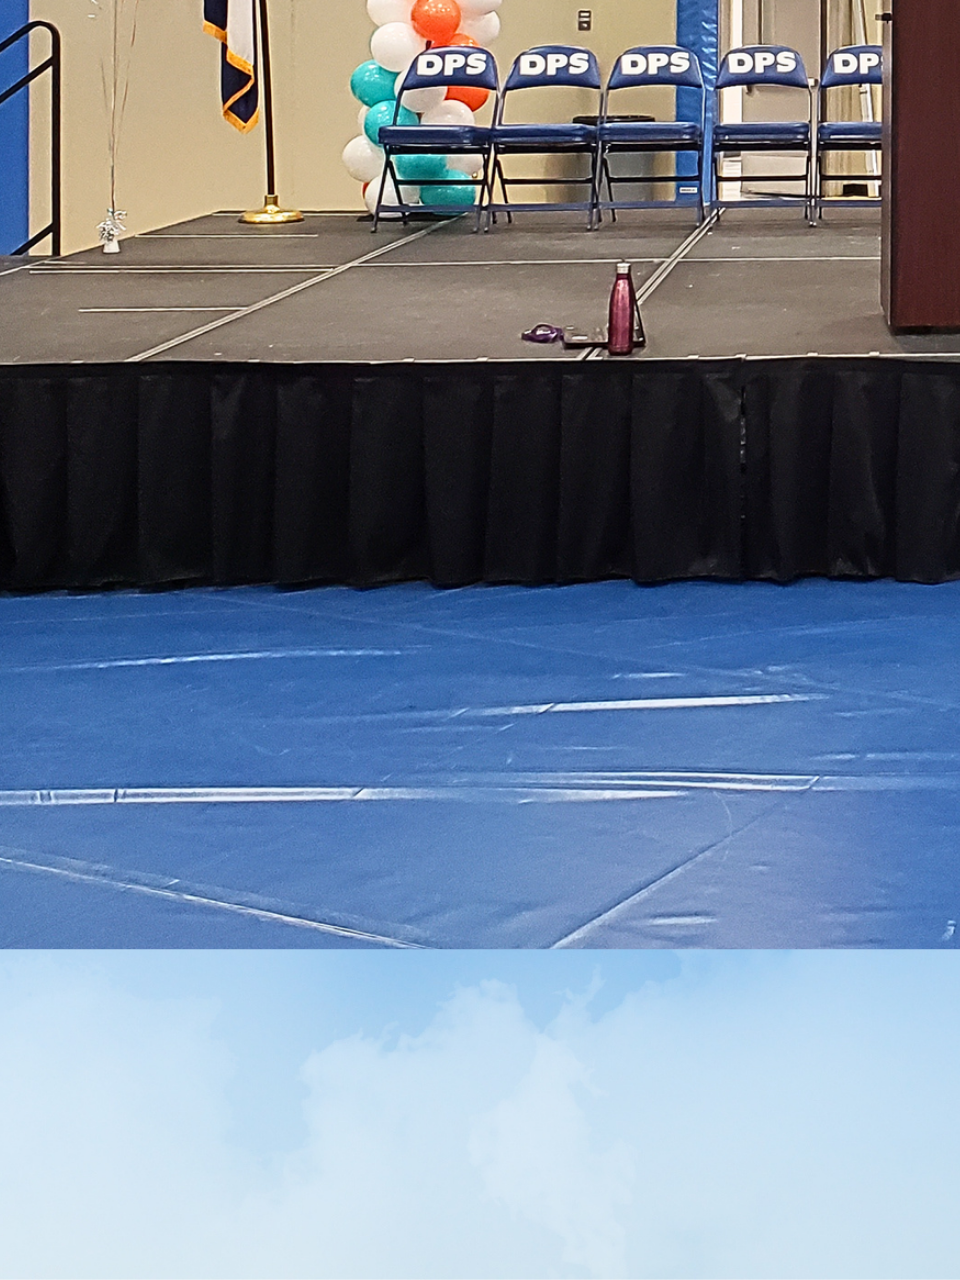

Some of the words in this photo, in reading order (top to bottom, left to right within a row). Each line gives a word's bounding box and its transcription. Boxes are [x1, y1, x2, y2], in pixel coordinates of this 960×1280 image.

[416, 54, 486, 77] DPS
[519, 53, 590, 76] DPS
[621, 52, 690, 75] DPS
[728, 52, 796, 74] DPS
[833, 53, 883, 74] DP
